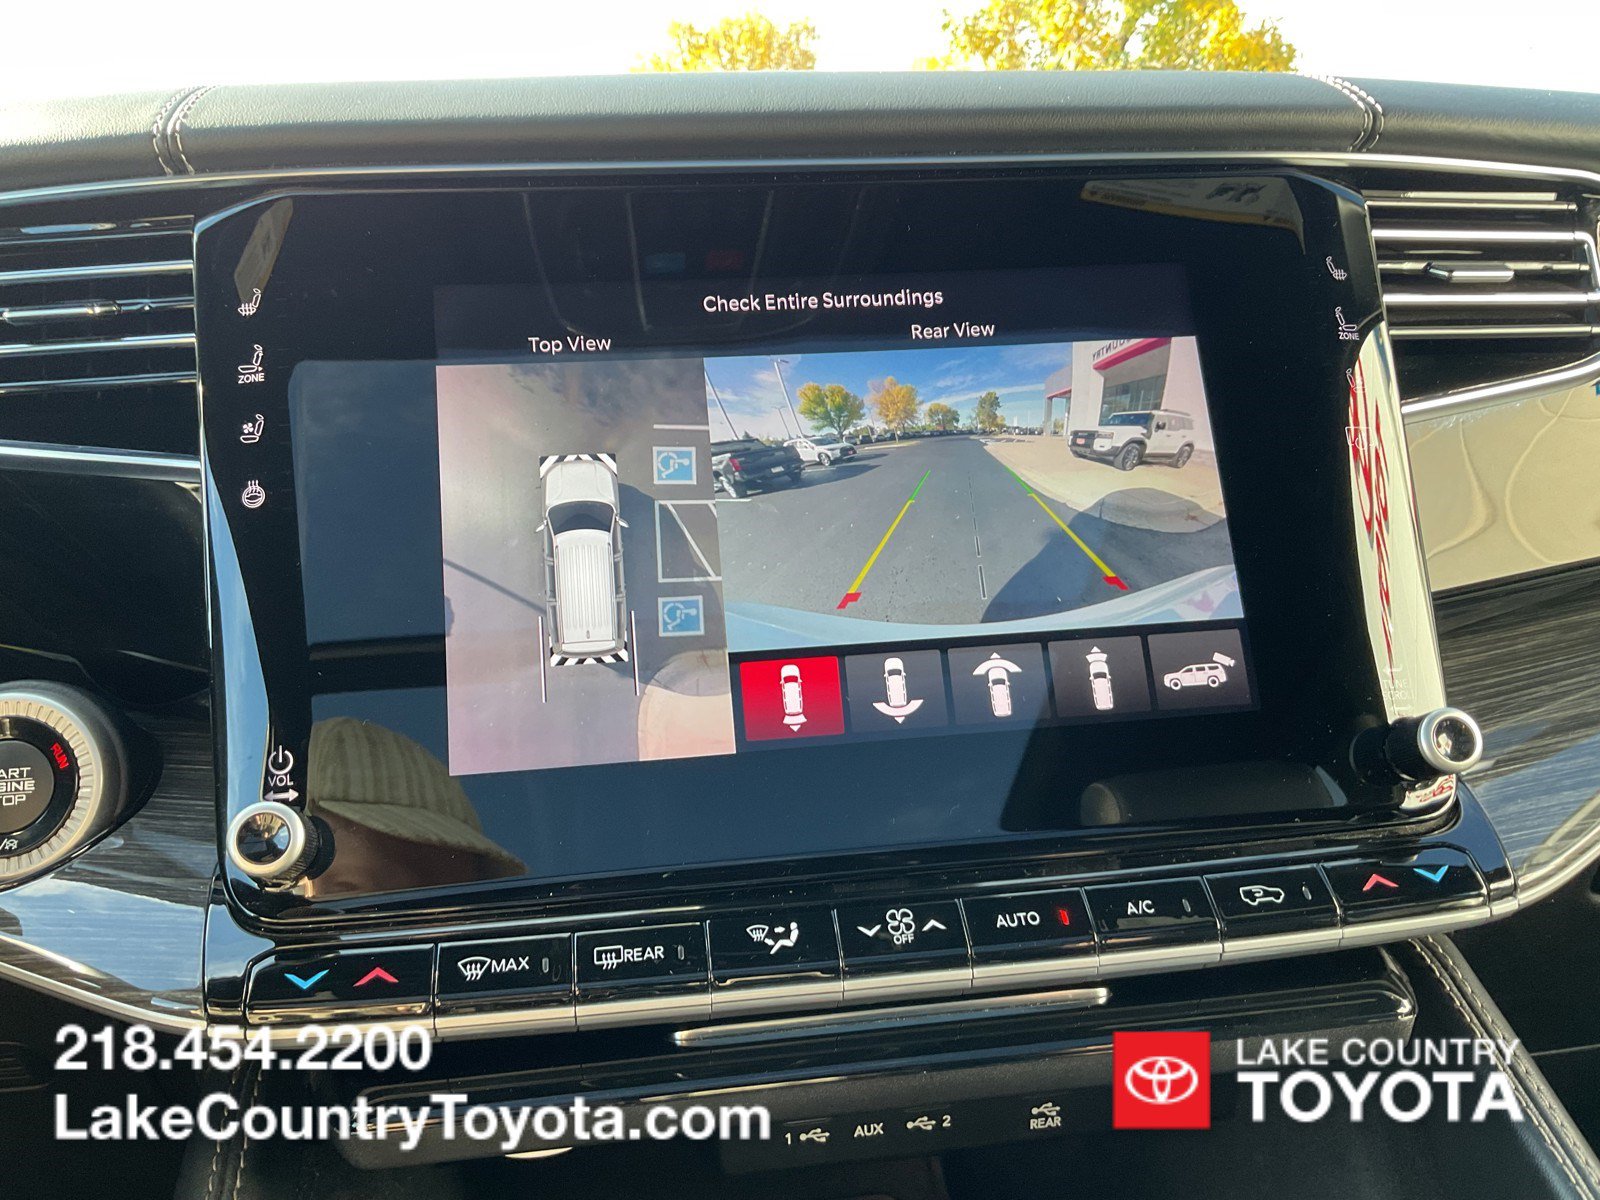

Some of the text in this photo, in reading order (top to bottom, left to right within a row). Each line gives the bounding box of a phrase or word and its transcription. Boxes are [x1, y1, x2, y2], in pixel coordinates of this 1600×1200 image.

[703, 288, 944, 313] Check Entire Surroundings
[911, 321, 995, 340] Rear View
[1338, 330, 1360, 341] ZONE
[528, 335, 612, 356] Top View
[237, 372, 265, 384] ZONE
[51, 742, 70, 770] RUN
[0, 766, 31, 779] ART
[0, 780, 36, 793] GINE
[267, 774, 294, 787] VOL
[0, 793, 27, 806] OP
[1127, 899, 1155, 916] A/C
[996, 911, 1040, 929] AUTO
[892, 933, 915, 945] OFF
[623, 945, 665, 963] REAR
[490, 956, 530, 974] MAX
[942, 1115, 951, 1127] 2
[1029, 1115, 1062, 1130] REAR
[853, 1122, 885, 1138] AUX
[785, 1132, 792, 1145] 1
